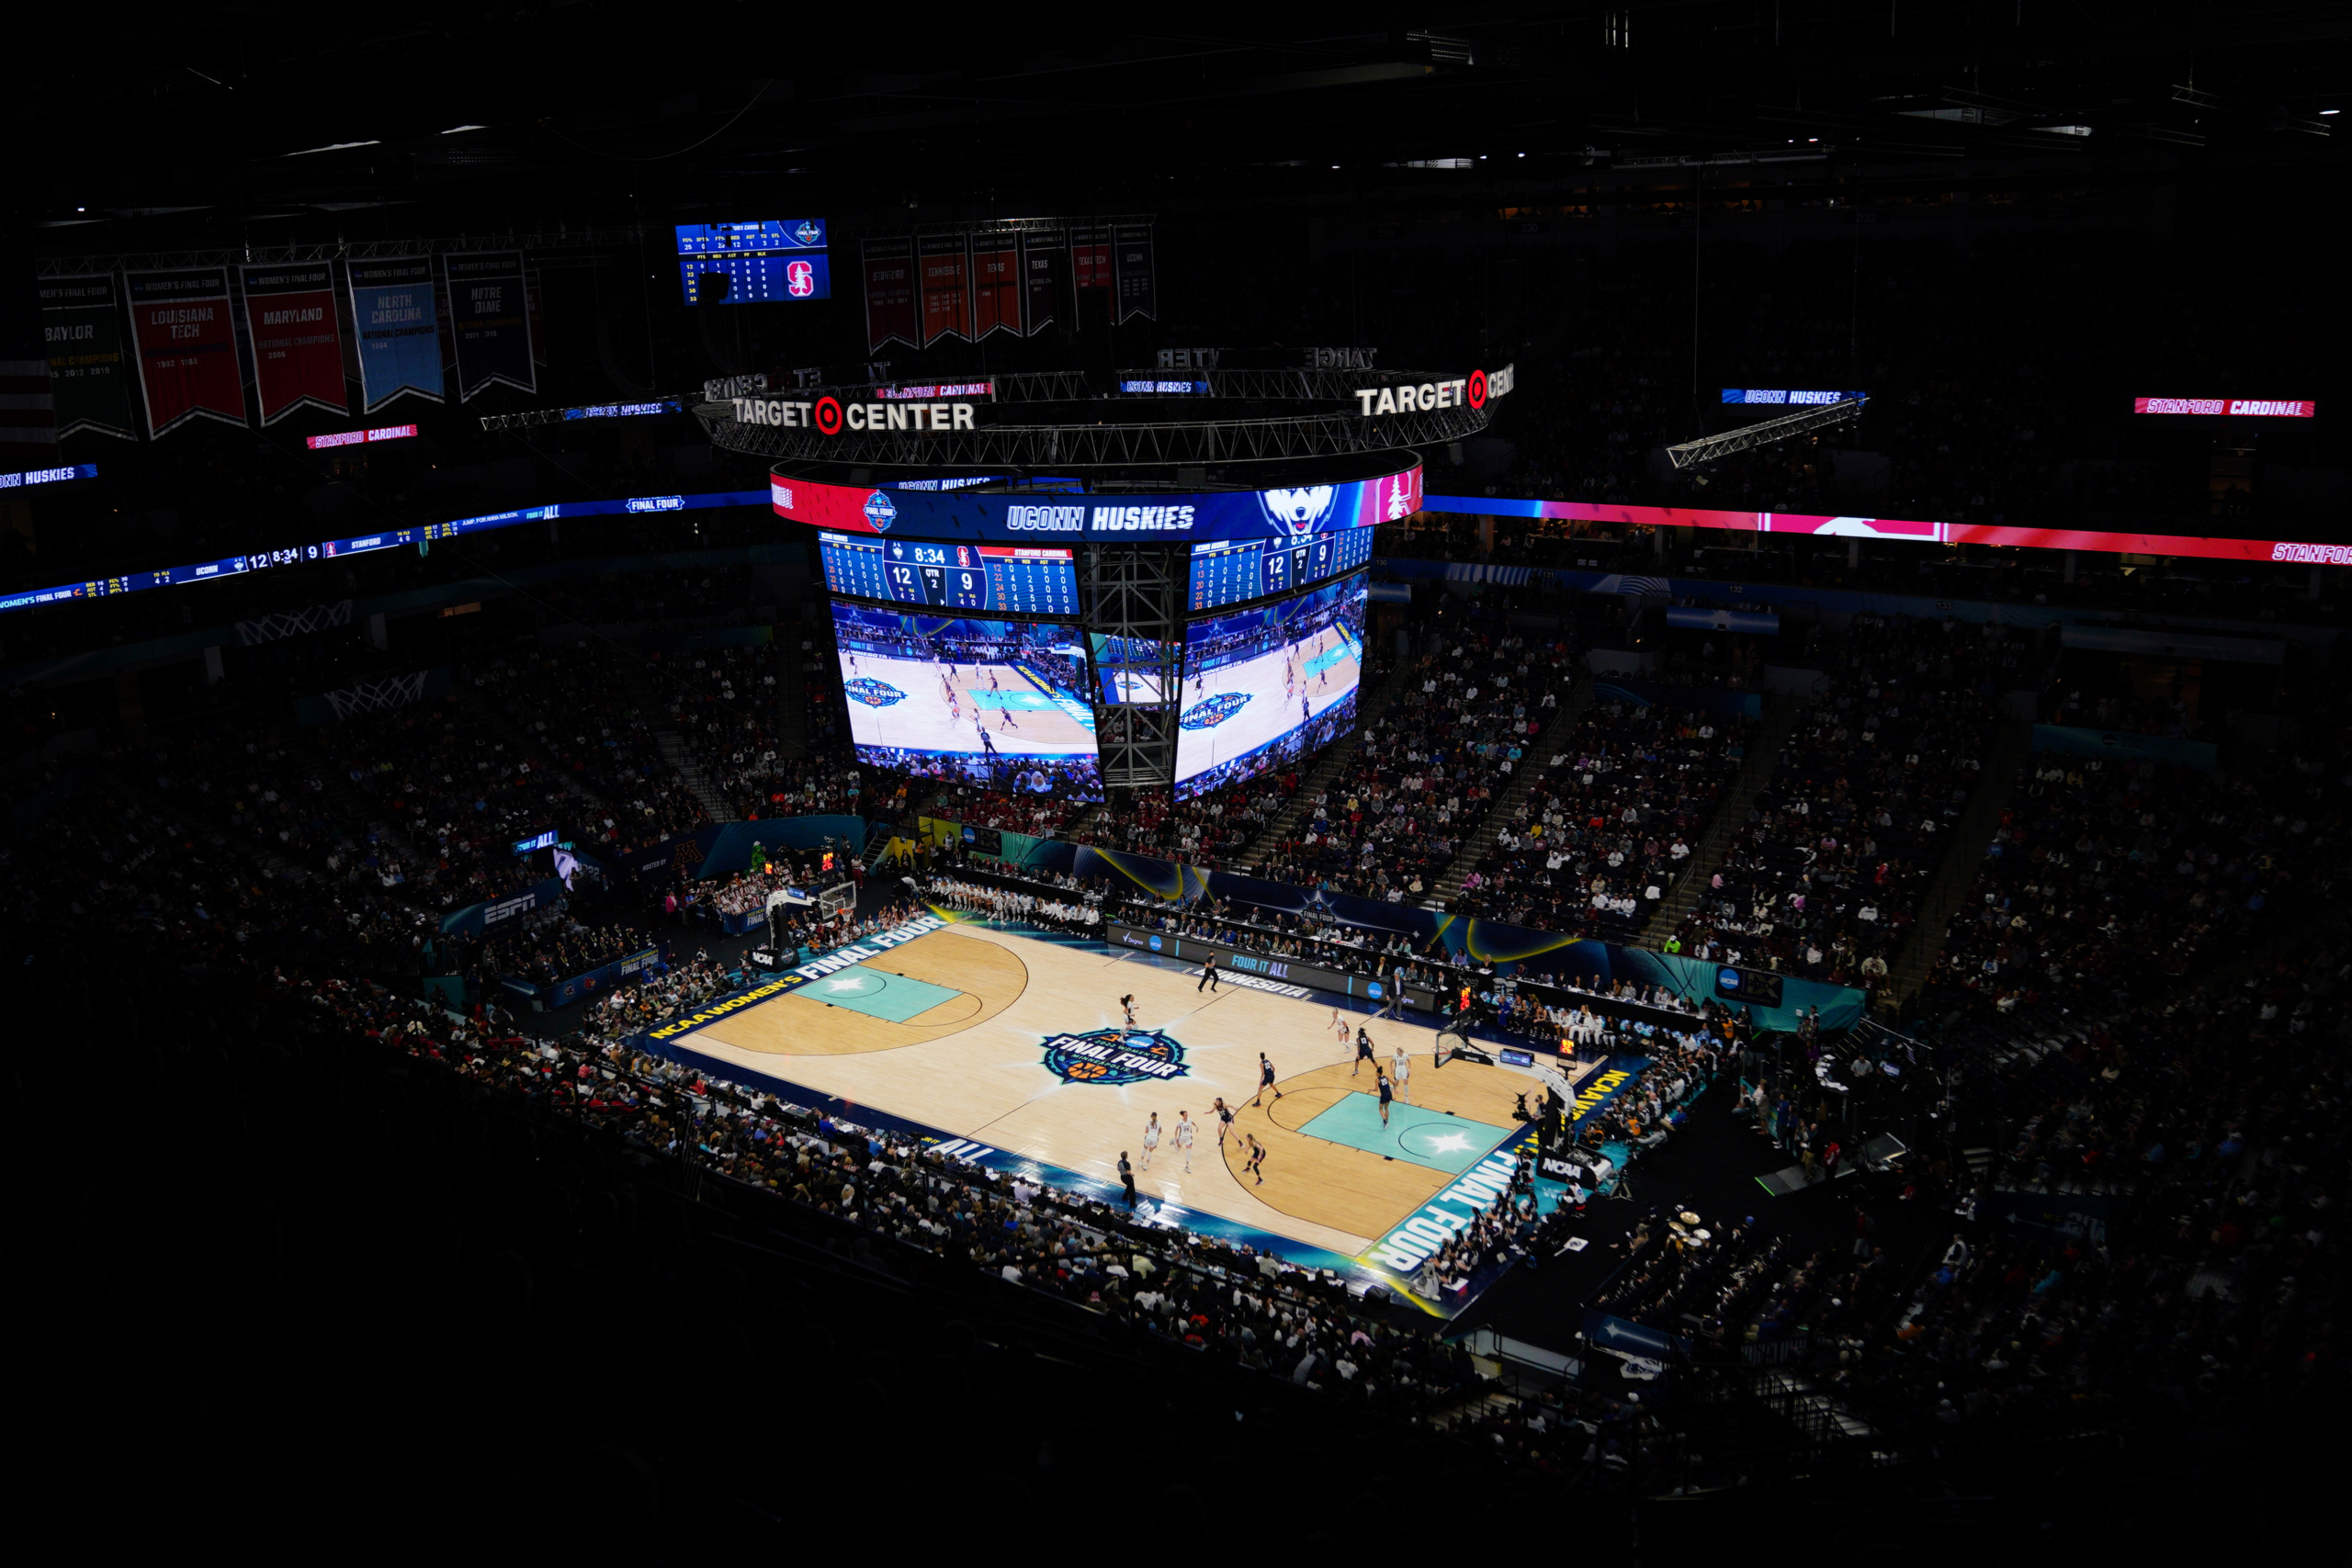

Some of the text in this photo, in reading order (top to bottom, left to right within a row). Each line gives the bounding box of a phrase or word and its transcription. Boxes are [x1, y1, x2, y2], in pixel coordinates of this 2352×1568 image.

[501, 261, 516, 269] FOUR
[1032, 259, 1048, 270] TEXAS
[1078, 256, 1093, 266] TEXAS
[1127, 253, 1143, 262] UCONN
[258, 273, 326, 285] WOMEN'S FINAL FOUR
[363, 266, 426, 279] WOMEN'S FINAL FOUR
[65, 286, 107, 297] FINAL FOUR
[145, 279, 220, 291] WOMEN'S FINAL FOUR
[471, 286, 502, 300] NOTRE
[378, 294, 412, 309] NORTH
[475, 299, 501, 314] DAME
[151, 307, 214, 325] LOUISIANA
[264, 307, 323, 325] MARYLAND
[371, 307, 422, 324] CAROLINA
[45, 325, 94, 342] BAYLOR
[170, 323, 200, 339] TECH
[362, 325, 435, 340] NATIONAL CHAMPIONS
[258, 334, 334, 349] NATIONAL CHAMPIONS
[68, 352, 119, 365] CHAMPIONS
[180, 358, 198, 366] 1988
[64, 369, 84, 377] 2012
[90, 367, 110, 375] 2019
[1356, 379, 1466, 416] TARGET
[1745, 390, 1841, 404] UCONN HUSKIES
[732, 397, 975, 430] TARGET CENTER
[2147, 398, 2302, 416] STANFORD CARDINAL
[316, 426, 411, 448] STANFORD CARDINAL
[26, 467, 75, 485] HUSKIES
[632, 499, 678, 510] FINAL FOUR
[865, 507, 893, 516] FINAL FOUR
[543, 505, 560, 520] ALL
[1007, 506, 1195, 531] UCONN HUSKIES
[250, 538, 381, 569] 12 8:34 9 STANFORD
[915, 547, 945, 564] 8:34
[1269, 545, 1326, 575] 12 QTR 2 9
[196, 565, 218, 575] UCONN
[1197, 570, 1204, 578] 13
[893, 567, 972, 590] 12 QTR 2 9
[1196, 581, 1204, 589] 20
[36, 590, 72, 602] FINAL FOUR
[1195, 592, 1203, 600] 22
[1195, 601, 1202, 610] 33
[1202, 654, 1230, 669] FOUR IT ALL
[873, 689, 902, 697] FOUR
[1217, 696, 1248, 712] FOUR
[531, 832, 554, 849] IT ALL
[642, 860, 659, 872] HOSTED
[822, 861, 833, 871] 26
[484, 893, 535, 924] ESPN
[747, 913, 764, 927] FINAL
[1304, 911, 1334, 923] FINAL FOUR
[795, 916, 950, 980] FINAL FOUR
[752, 952, 774, 966] NCAA
[1231, 954, 1288, 978] FOUR IT ALL
[621, 961, 640, 976] FINAL
[1193, 968, 1310, 997] MNNESOTA
[649, 975, 803, 1040] NCAA WOMEN'S
[1049, 1036, 1178, 1077] FINAL FOUR
[1095, 1039, 1159, 1059] 2022 WOMEN'S
[1071, 1053, 1130, 1072] MINNEAPOLIS
[1381, 1078, 1387, 1086] 20
[1579, 1069, 1630, 1103] NCAA
[1542, 1158, 1582, 1179] NCAA
[1378, 1149, 1517, 1272] FINAL FOUR
